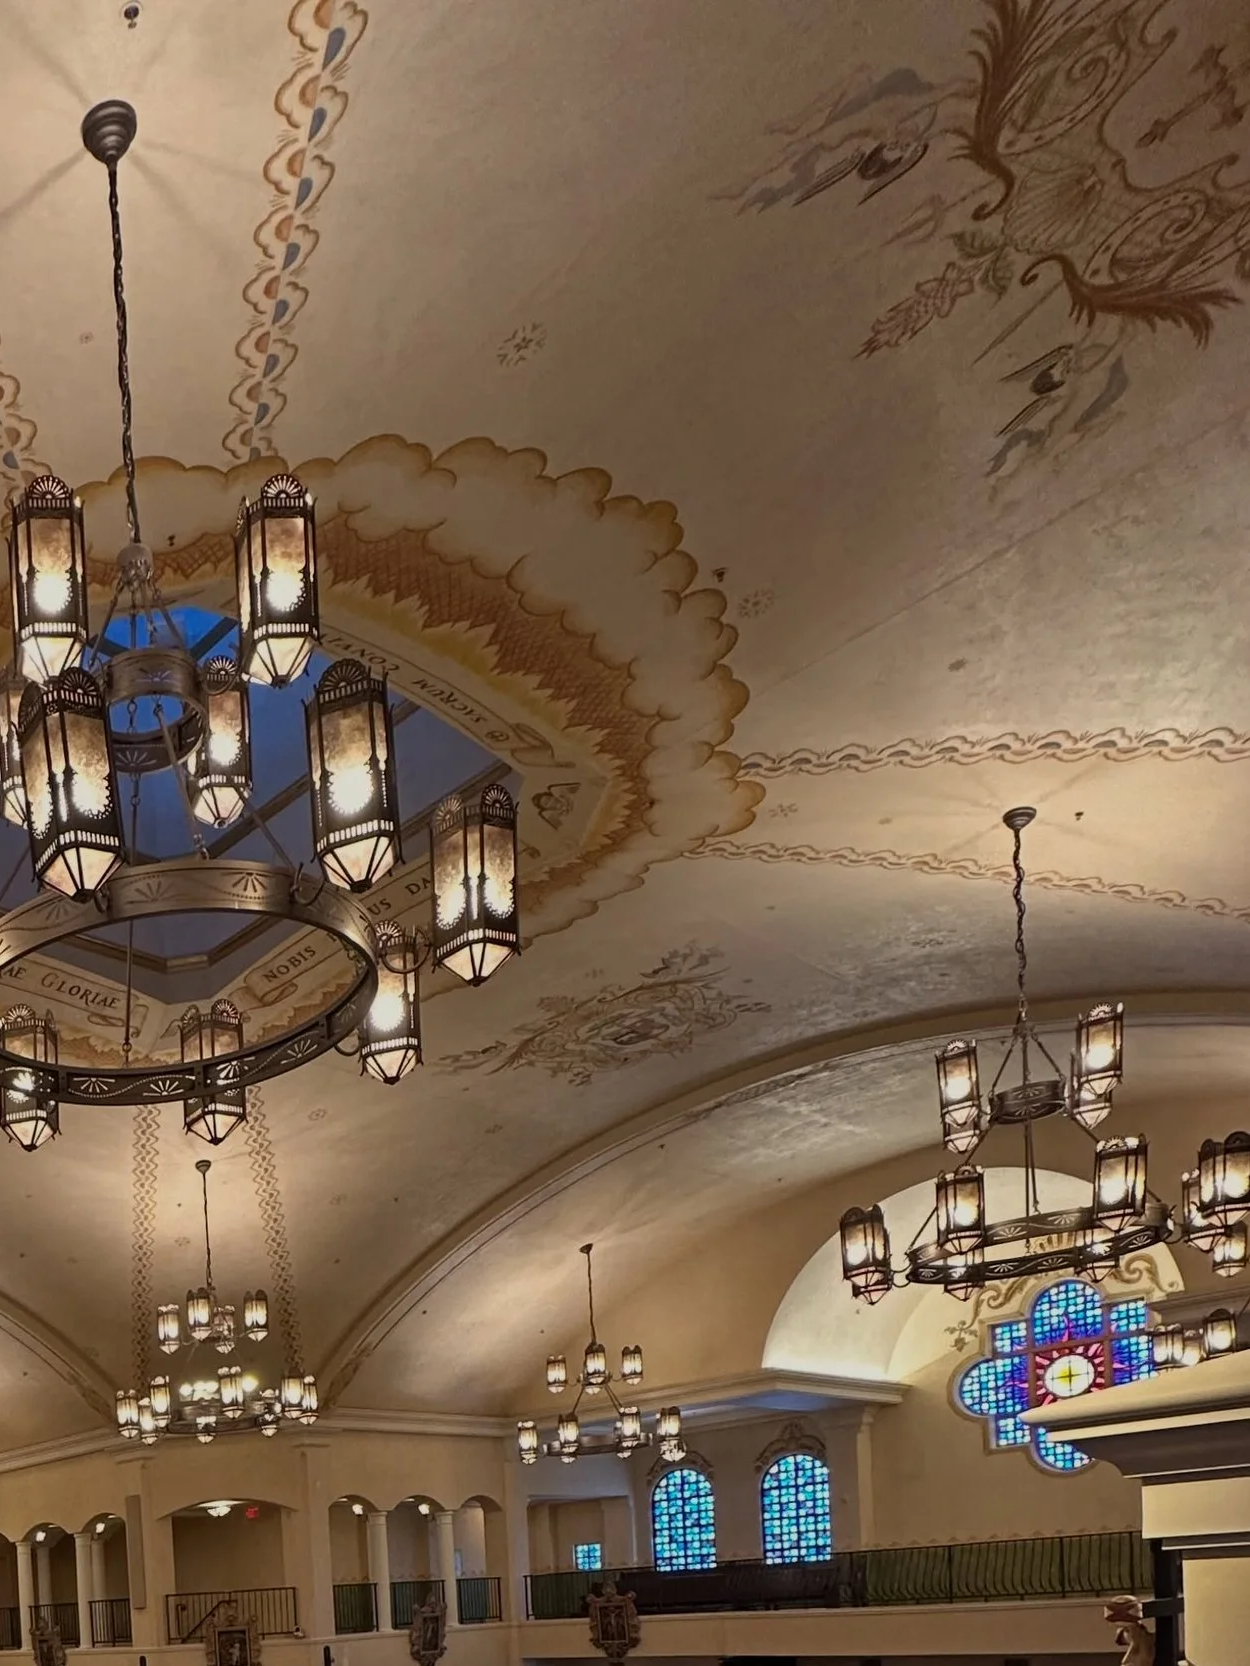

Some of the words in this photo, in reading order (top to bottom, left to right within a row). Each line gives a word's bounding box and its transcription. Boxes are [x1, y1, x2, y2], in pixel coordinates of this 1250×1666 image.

[411, 678, 488, 723] SACRUM
[263, 945, 316, 983] NOBIS
[41, 972, 120, 1010] GLORIAE
